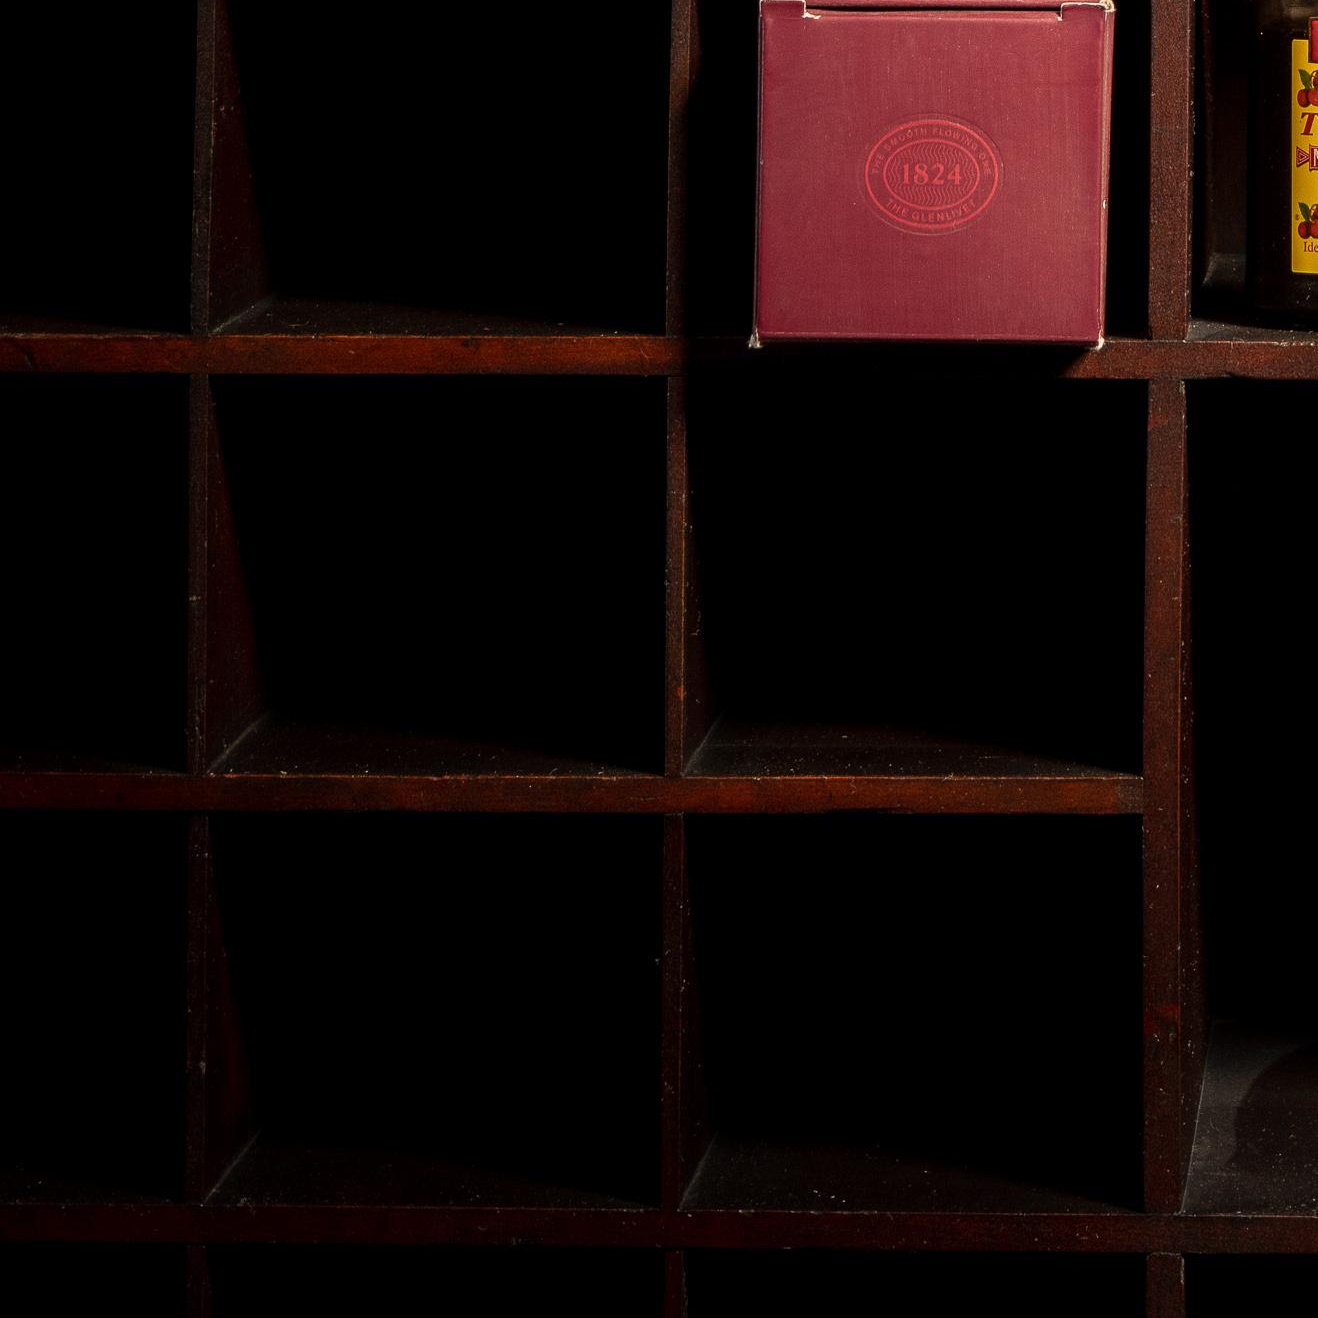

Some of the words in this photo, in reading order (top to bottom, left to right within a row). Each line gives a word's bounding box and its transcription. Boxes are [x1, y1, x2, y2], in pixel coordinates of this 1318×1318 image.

[884, 128, 928, 151] SMOOTH
[932, 127, 978, 151] FLOWING
[902, 162, 962, 186] 1824
[885, 198, 909, 217] THE
[911, 199, 977, 222] GLENLIVET
